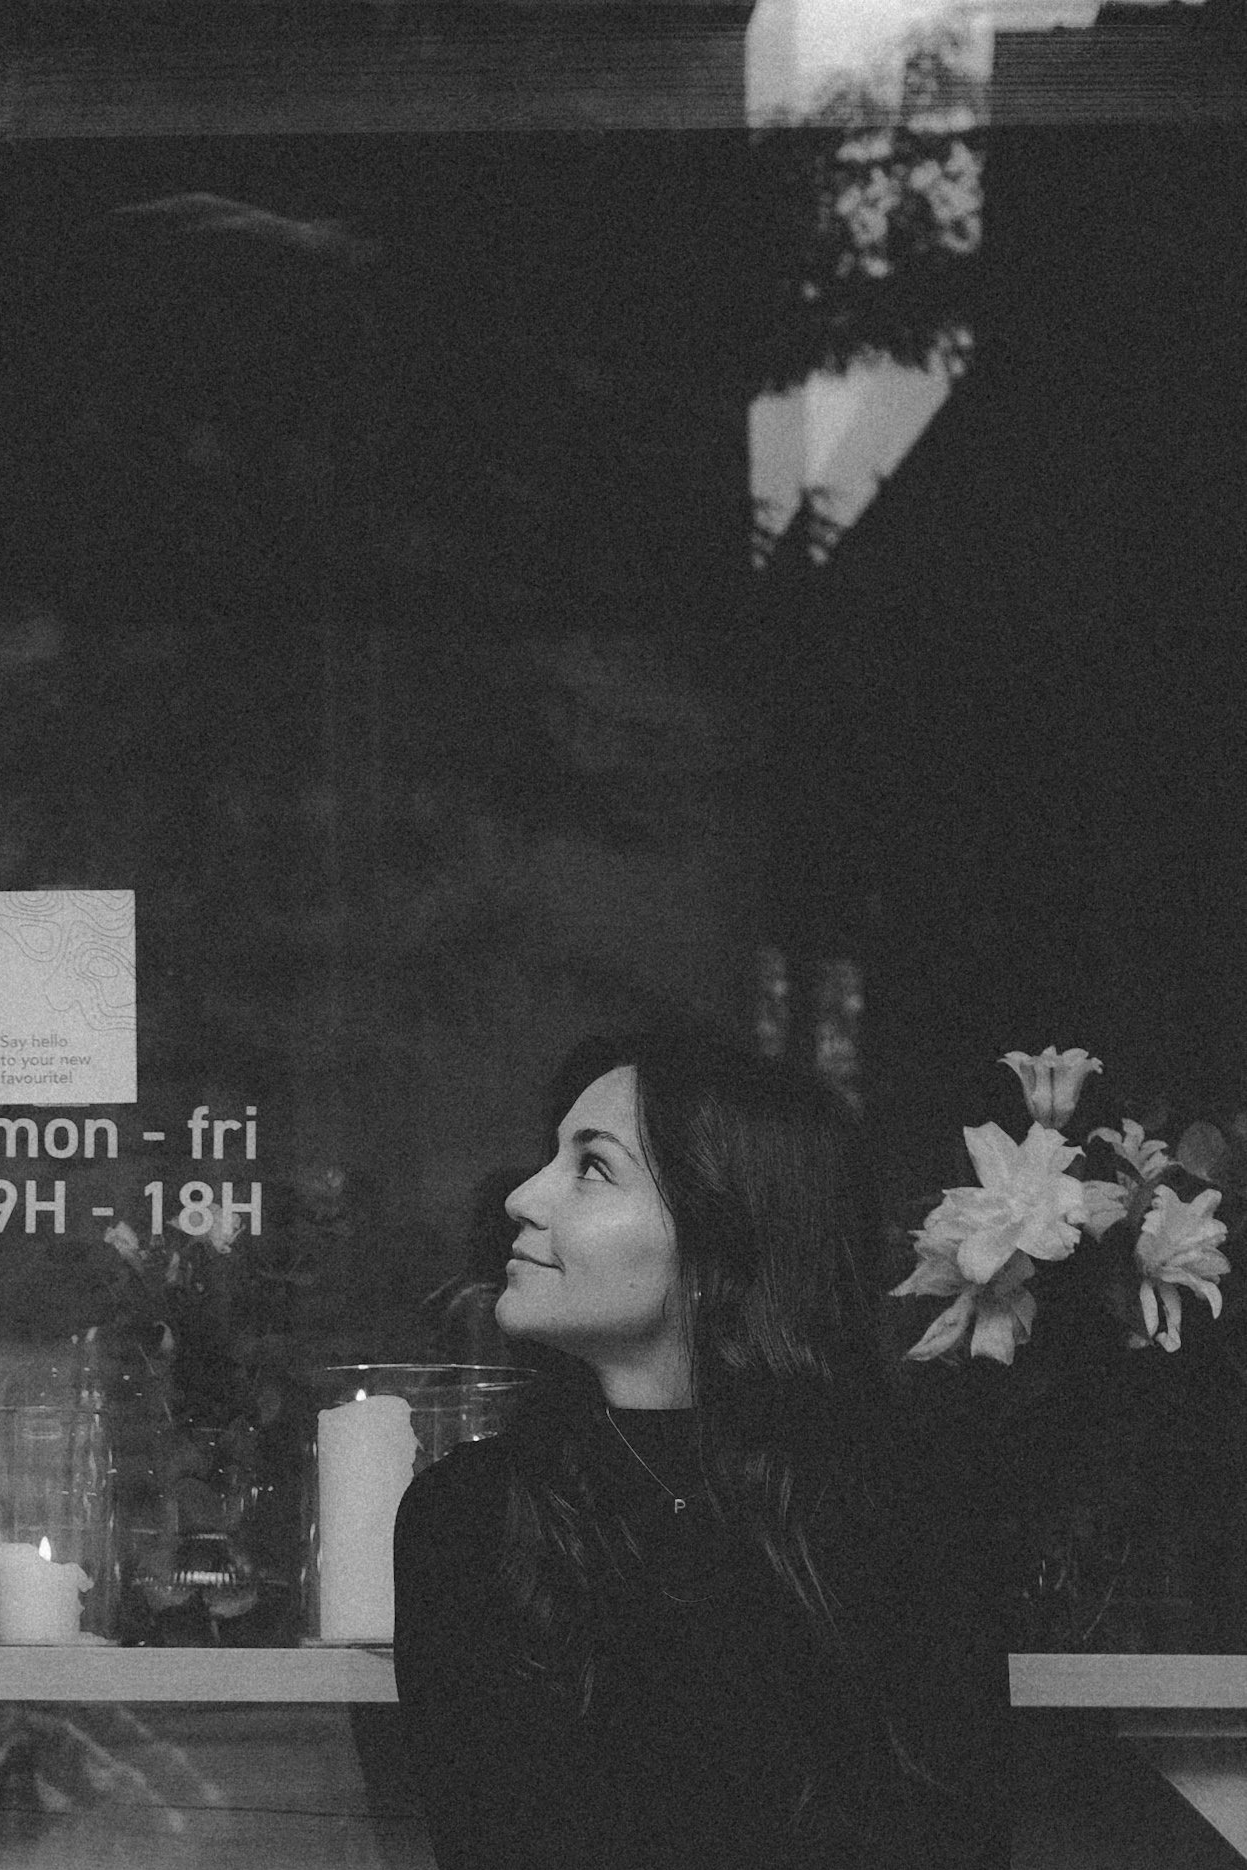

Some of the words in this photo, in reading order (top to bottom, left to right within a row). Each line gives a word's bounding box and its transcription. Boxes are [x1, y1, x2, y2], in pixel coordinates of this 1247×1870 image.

[0, 1034, 26, 1052] Say
[31, 1033, 68, 1048] hello
[0, 1056, 16, 1067] to
[21, 1056, 55, 1070] your
[59, 1056, 92, 1067] new
[0, 1071, 74, 1085] favourite!
[187, 1105, 257, 1160] fri
[143, 1180, 263, 1236] 18H
[674, 1498, 686, 1514] P
